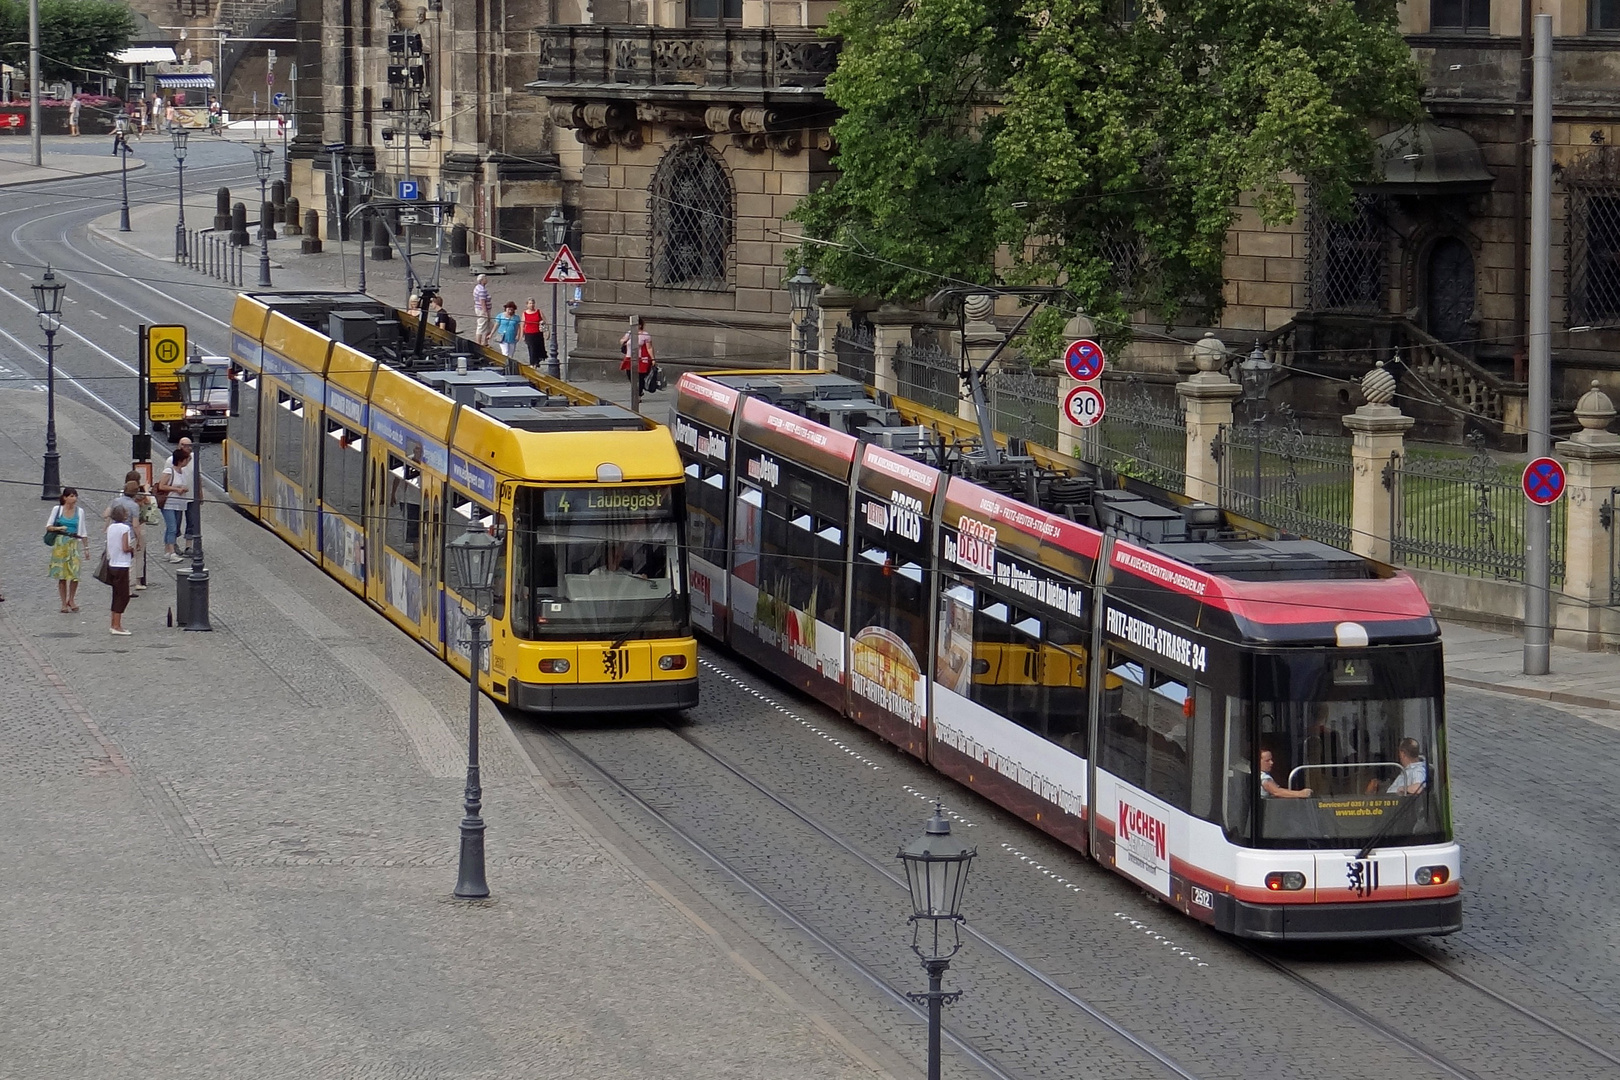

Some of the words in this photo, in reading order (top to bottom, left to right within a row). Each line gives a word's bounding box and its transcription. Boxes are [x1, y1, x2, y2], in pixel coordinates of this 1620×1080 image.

[403, 183, 413, 198] P
[162, 345, 173, 358] H
[1073, 397, 1096, 415] 30
[760, 454, 779, 488] Design
[558, 491, 570, 513] 4
[588, 490, 661, 511] Laubegast
[890, 490, 923, 543] PREIS
[979, 498, 1001, 515] DRESDEN
[1002, 507, 1054, 537] FRITZ-REUTER-STRASSE
[1053, 527, 1061, 539] 34
[944, 535, 957, 563] Das
[997, 562, 1011, 587] was
[1011, 563, 1037, 599] Dresden
[1037, 579, 1046, 602] zu
[1046, 578, 1067, 611] bieten
[1067, 587, 1082, 618] hat!
[1116, 551, 1206, 595] WWW.KUECHENZENTRUM-DRESDEN.DE
[1106, 606, 1191, 667] FRITZ-REUTER-STRASSE
[1192, 643, 1206, 672] 34
[1345, 661, 1355, 676] 4
[935, 716, 957, 750] Sprechen
[1335, 808, 1383, 816] www.dvb.de
[1119, 799, 1166, 861] KÜCHEN
[1194, 889, 1210, 907] 2512
